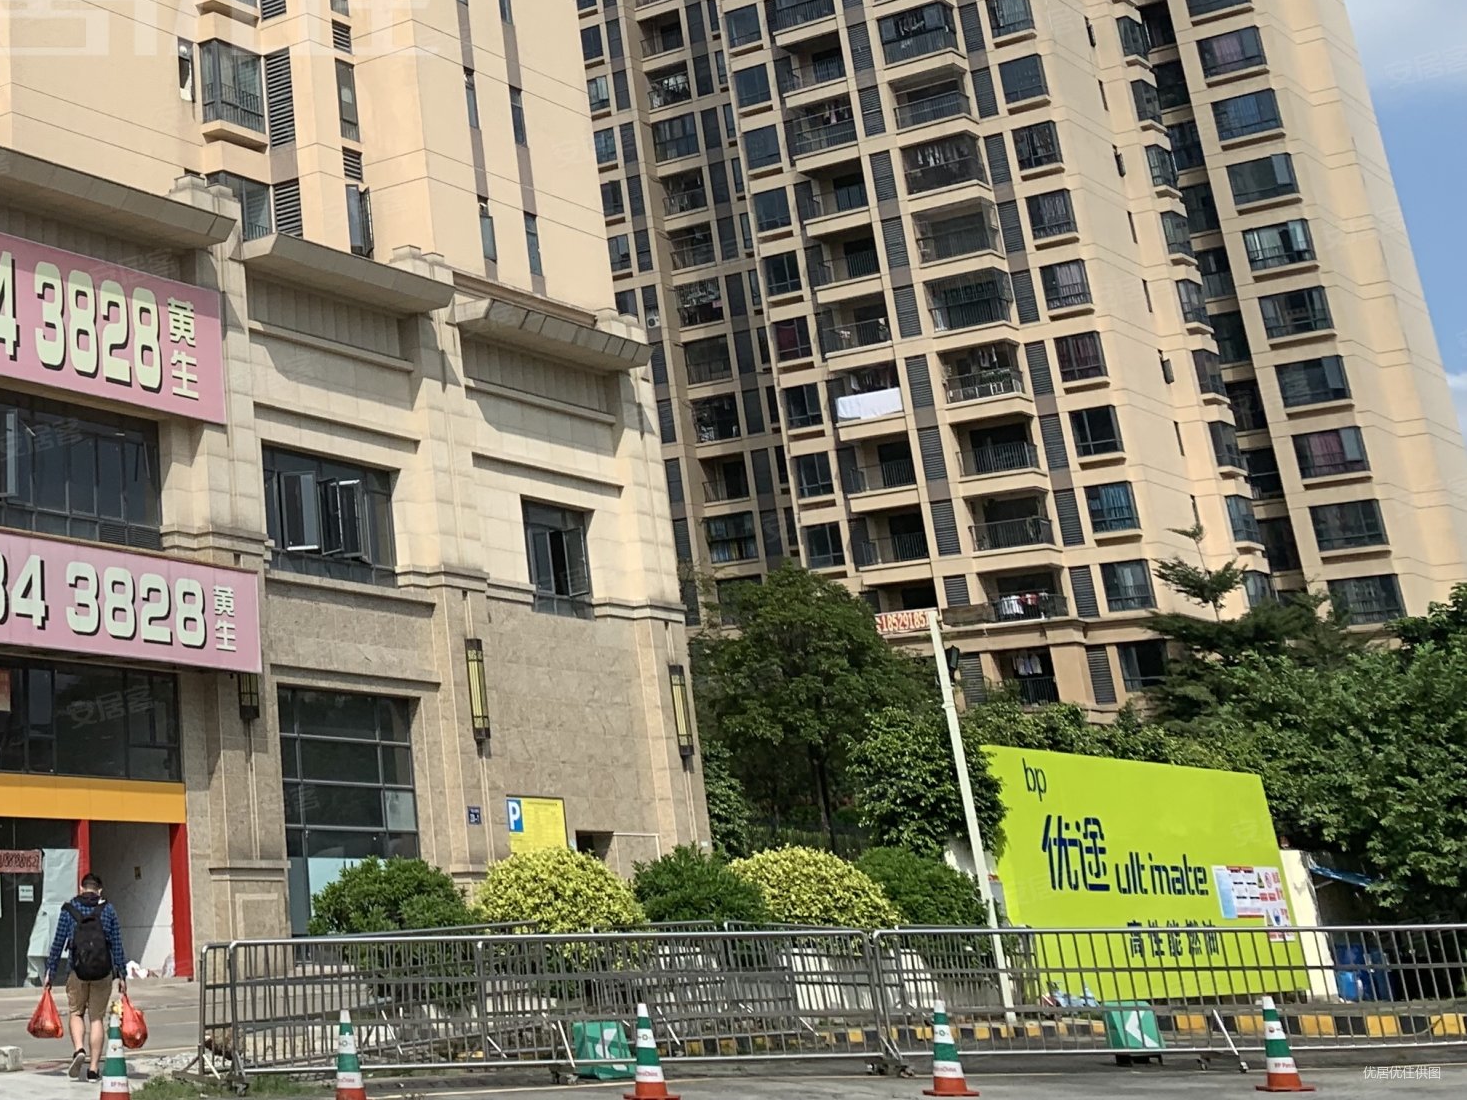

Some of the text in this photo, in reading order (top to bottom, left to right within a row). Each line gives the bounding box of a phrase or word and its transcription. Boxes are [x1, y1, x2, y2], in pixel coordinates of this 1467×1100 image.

[34, 261, 164, 396] 3828
[167, 296, 200, 401] 黄生
[66, 561, 208, 650] 3828
[213, 585, 237, 652] 黄生
[508, 801, 521, 830] P
[1022, 757, 1047, 802] bp
[1042, 814, 1110, 891] 优途
[1115, 851, 1209, 896] ultimate
